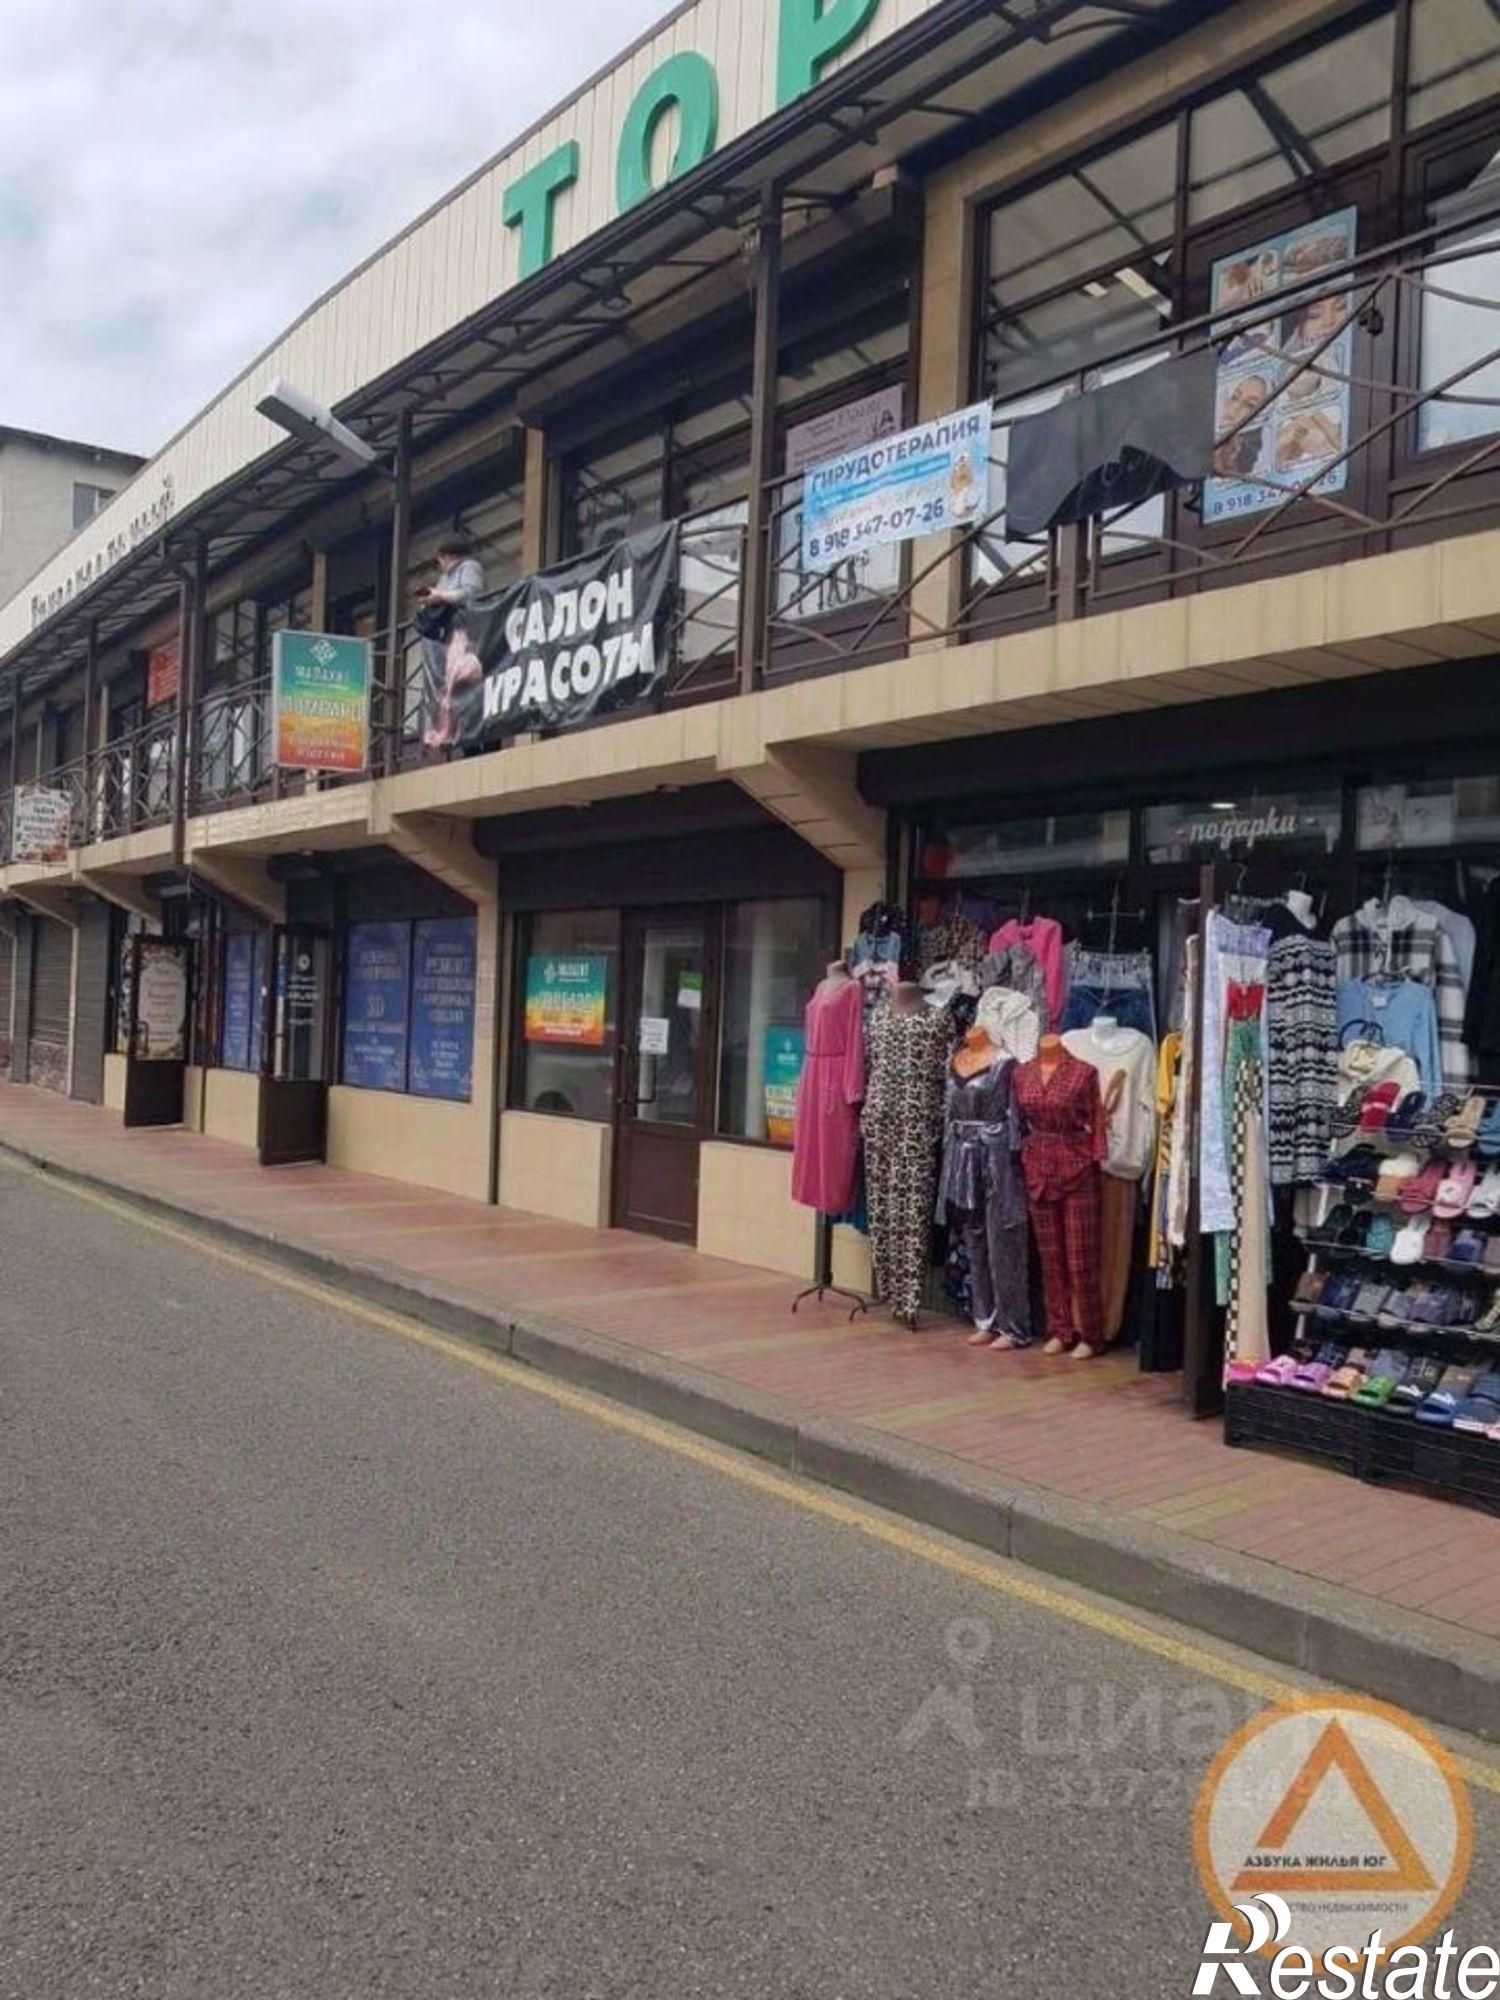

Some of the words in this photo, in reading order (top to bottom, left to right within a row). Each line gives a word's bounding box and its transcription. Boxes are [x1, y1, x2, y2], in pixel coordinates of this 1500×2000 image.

[811, 414, 981, 494] ГИРУДОТЕРАПИЯ
[809, 538, 820, 558] 8
[505, 566, 634, 654] САЛОН
[1190, 806, 1297, 850] подарки
